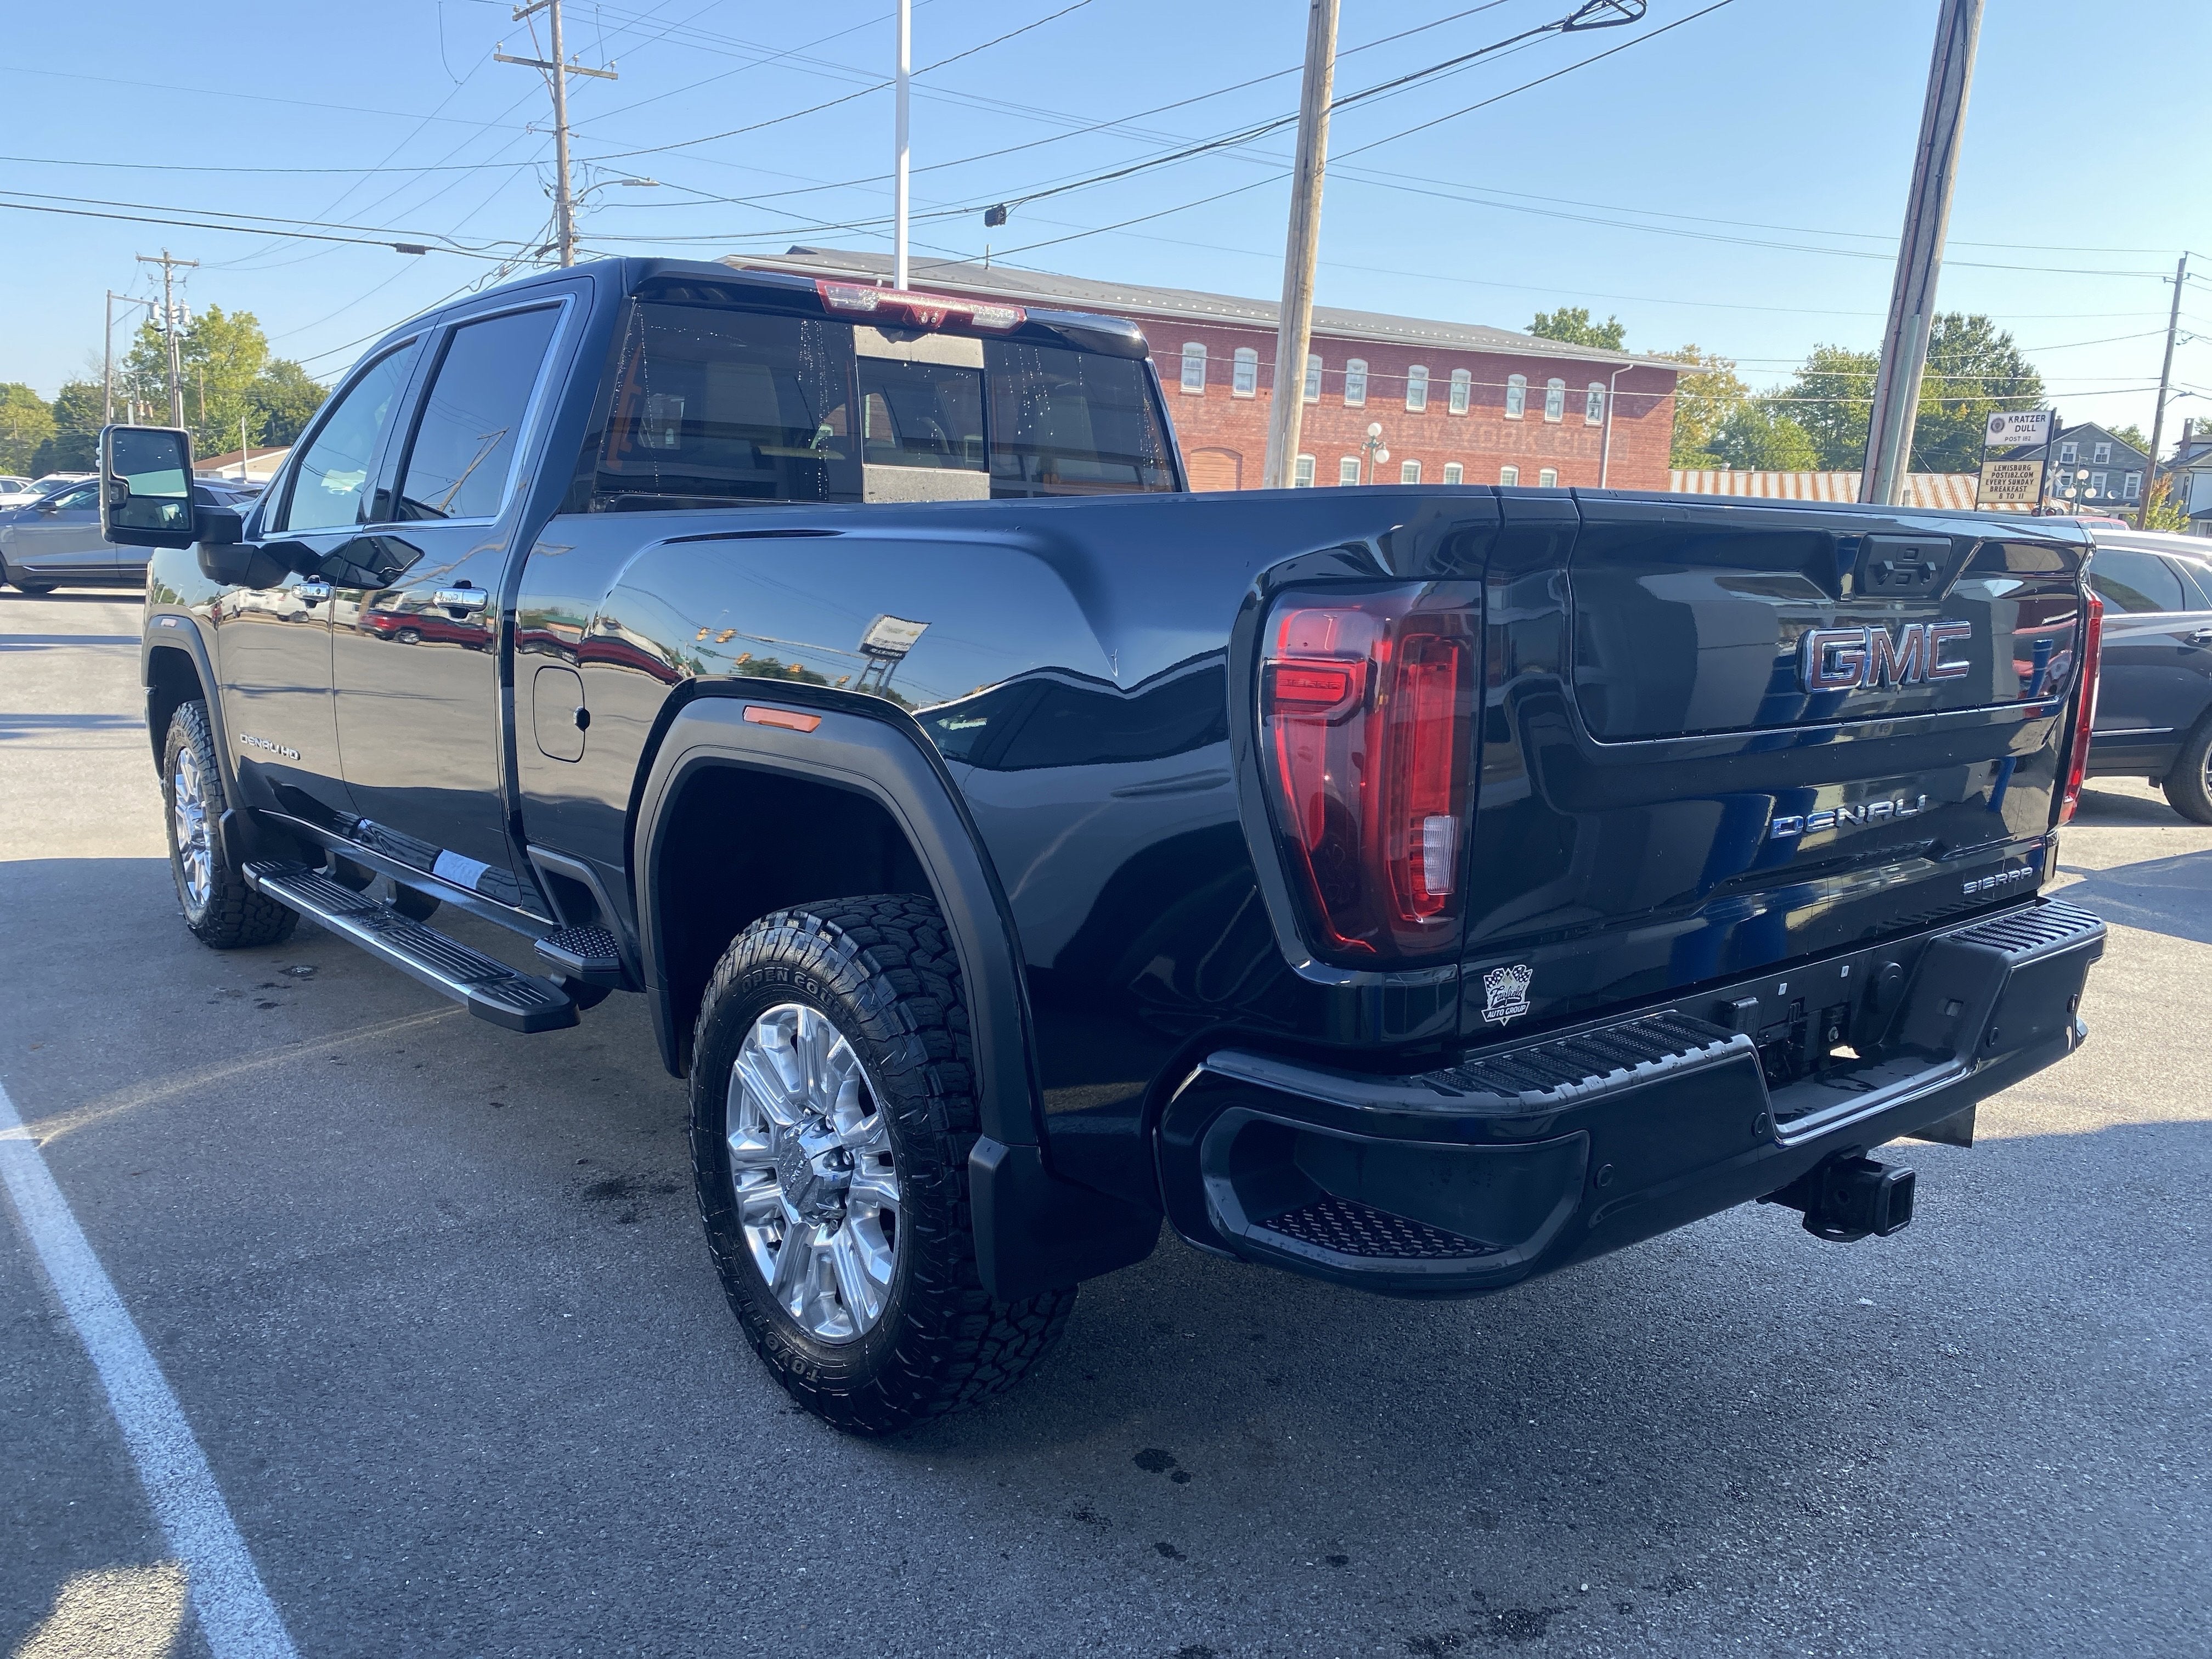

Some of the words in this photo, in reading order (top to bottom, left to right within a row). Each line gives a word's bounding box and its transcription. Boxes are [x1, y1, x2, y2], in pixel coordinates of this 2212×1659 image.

[2008, 414, 2046, 424] KRATZER
[1796, 620, 1972, 693] GMC
[240, 733, 281, 754] DENALI
[281, 746, 301, 761] HD
[1770, 794, 1927, 839] DENALI
[1962, 866, 2033, 895] SIERRA
[741, 967, 789, 993] OPEN
[1487, 1009, 1504, 1019] AUTO
[1505, 1004, 1526, 1015] GROUP
[765, 1332, 822, 1384] TOYO
